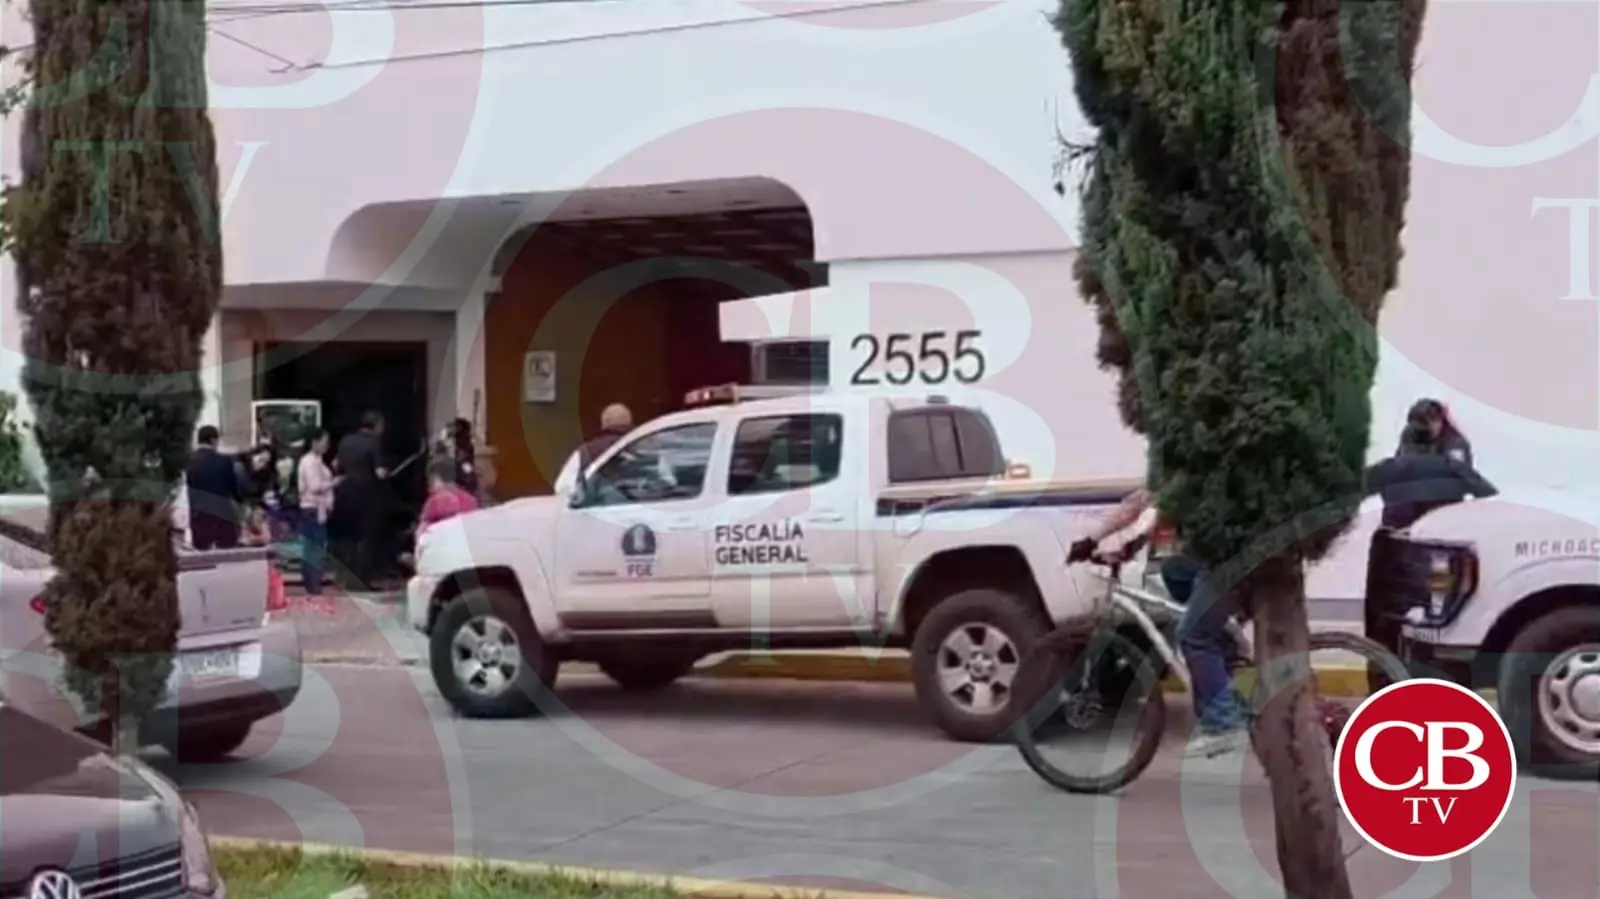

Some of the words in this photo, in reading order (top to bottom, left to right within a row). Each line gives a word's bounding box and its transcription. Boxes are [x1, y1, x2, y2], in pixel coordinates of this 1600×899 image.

[850, 329, 986, 386] 2555
[714, 518, 804, 543] FISCALÍA
[715, 545, 808, 565] GENERAL
